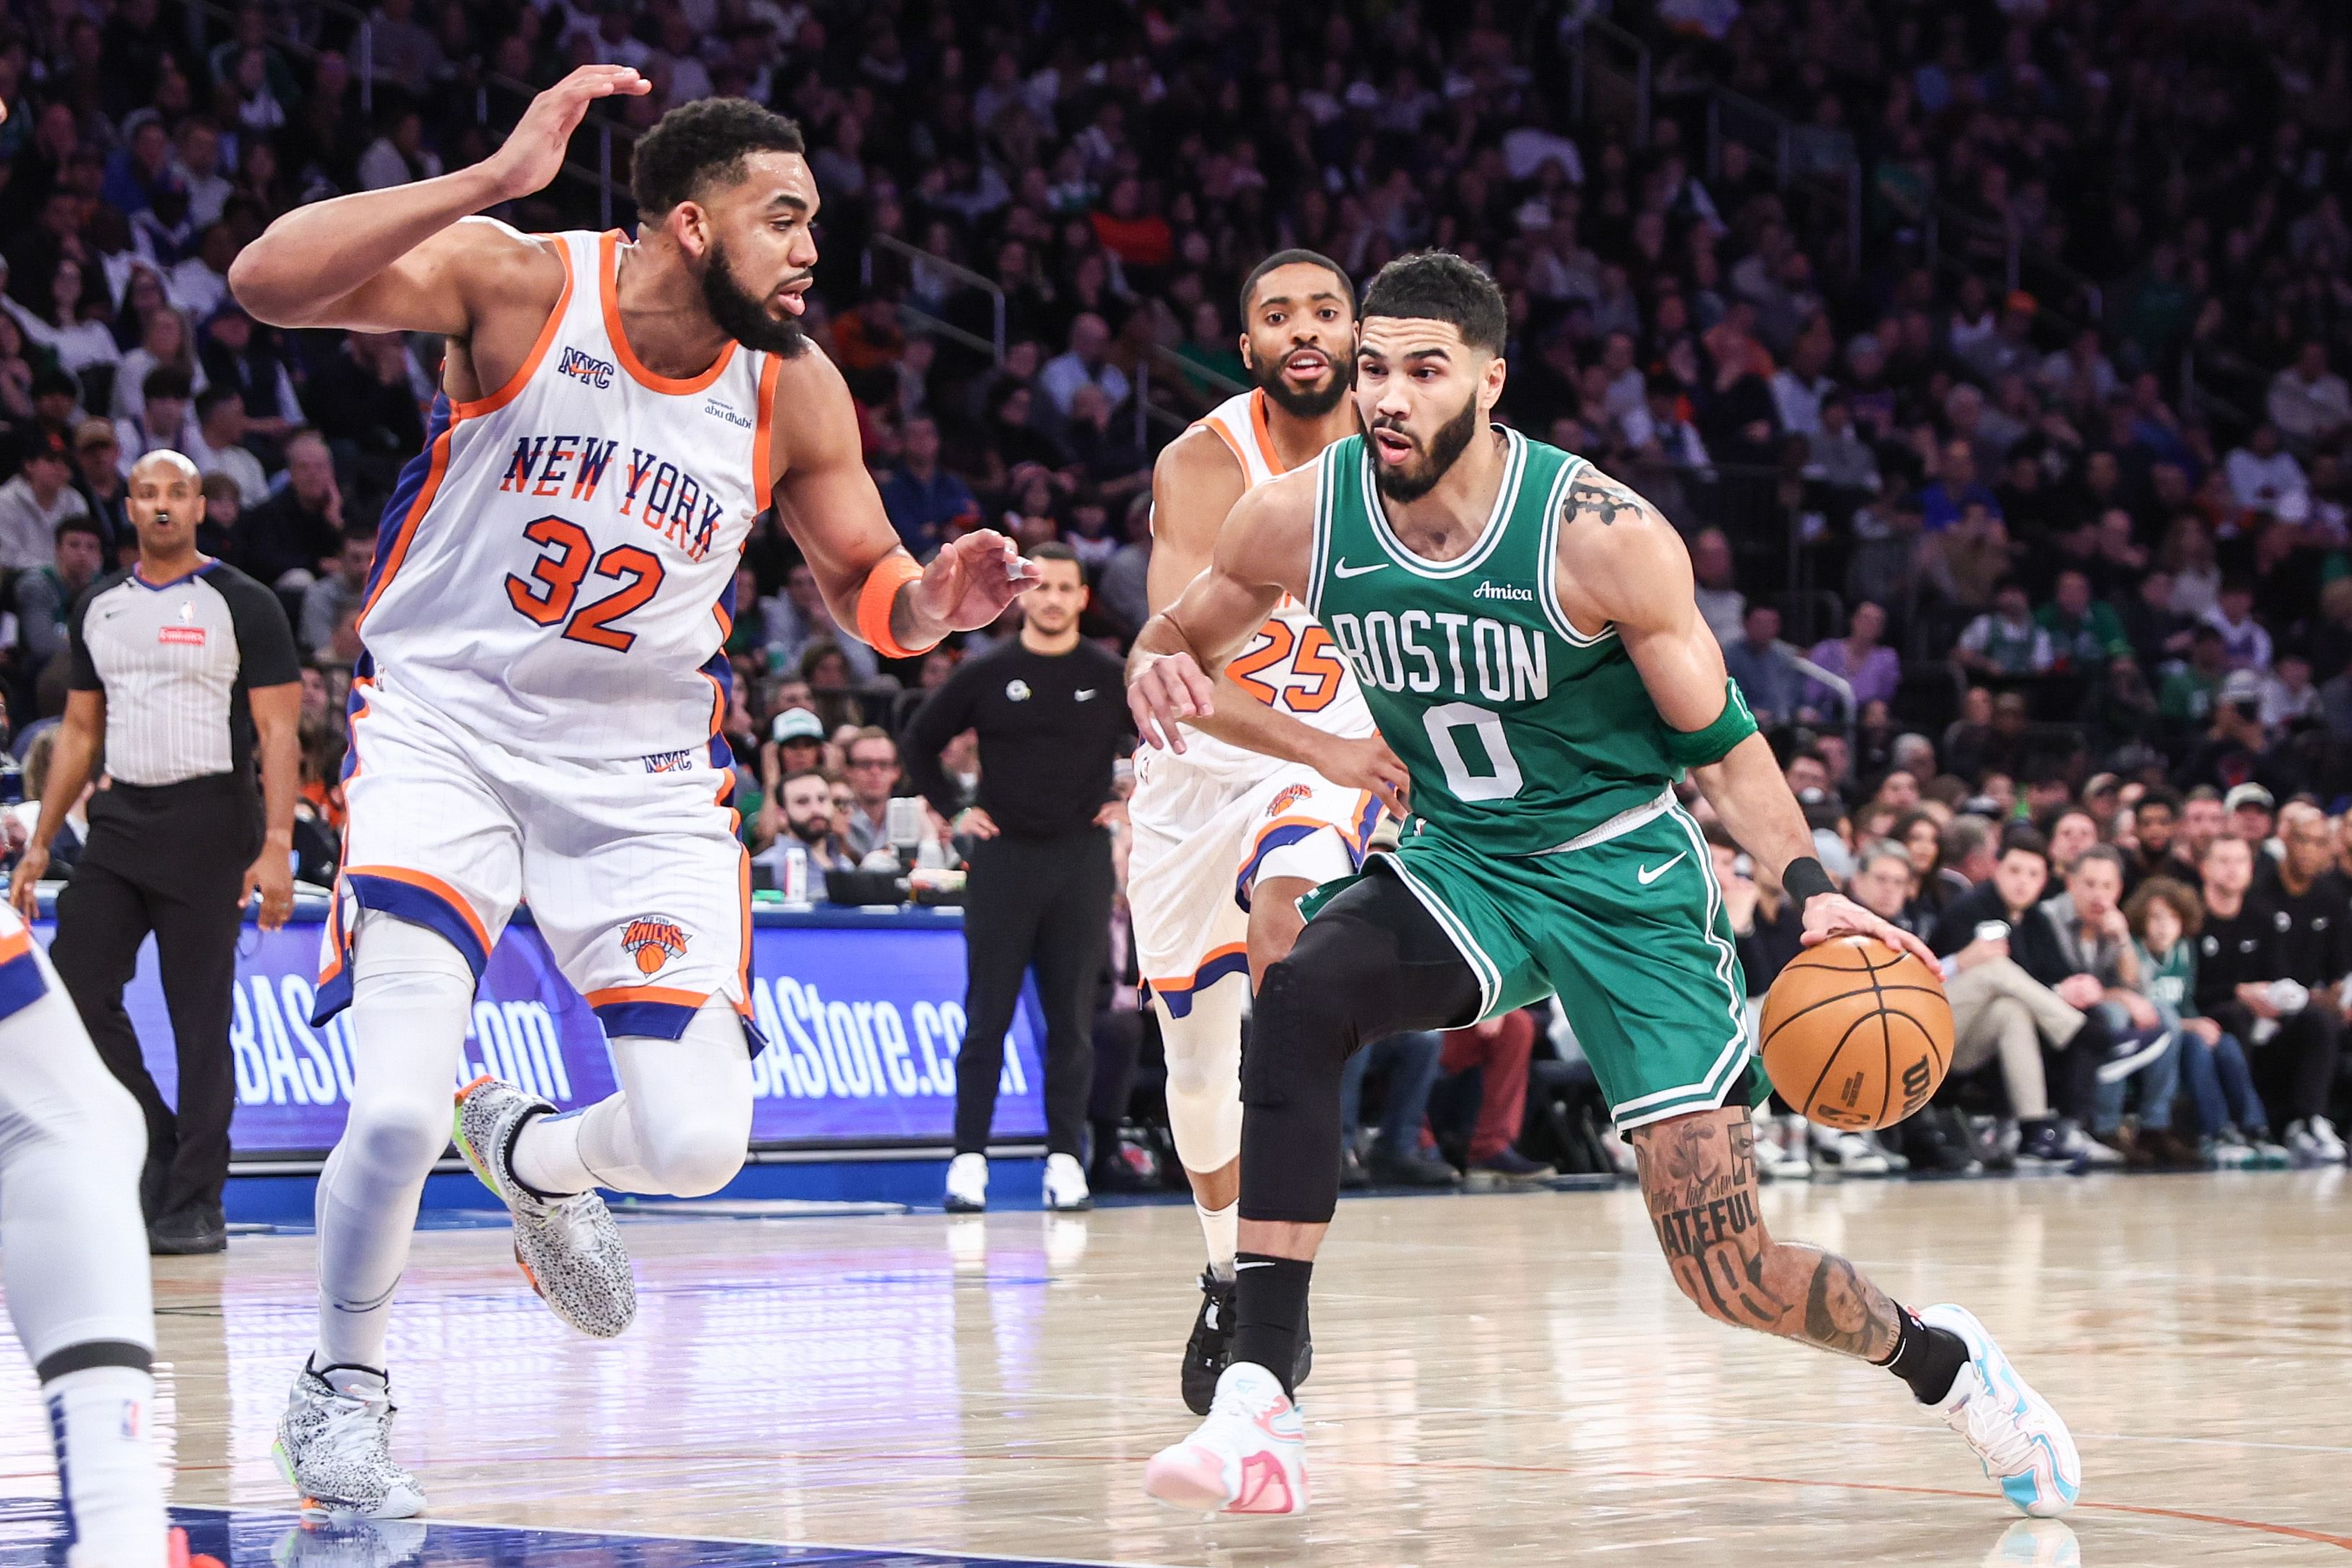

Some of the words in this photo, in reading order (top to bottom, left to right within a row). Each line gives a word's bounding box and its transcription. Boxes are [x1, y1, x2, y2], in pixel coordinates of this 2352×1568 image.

[558, 345, 615, 389] NYC
[704, 405, 723, 419] abu
[725, 412, 752, 429] dhabi
[499, 435, 619, 502] NEW
[619, 447, 723, 563] YORK
[504, 514, 666, 653] 32
[1473, 580, 1533, 602] Amica
[1224, 618, 1345, 713] 25
[1331, 609, 1549, 702] BOSTON
[641, 749, 692, 774] NYC
[1422, 701, 1524, 802] 0
[621, 920, 688, 953] KNICKS
